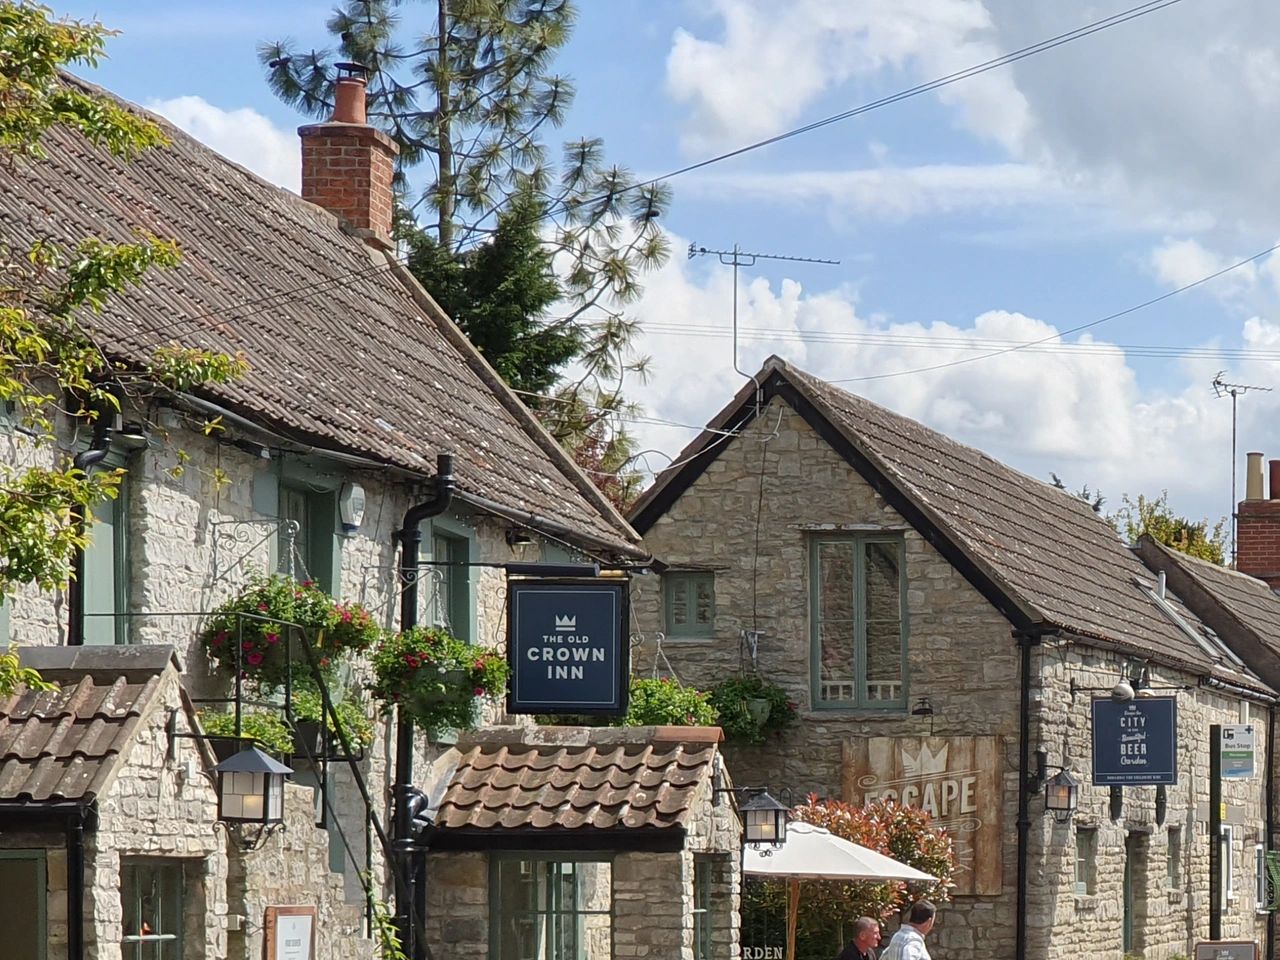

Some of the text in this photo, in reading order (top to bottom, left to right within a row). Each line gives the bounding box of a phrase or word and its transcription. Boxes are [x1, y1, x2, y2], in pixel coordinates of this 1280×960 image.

[542, 635, 589, 643] THE OLD
[527, 647, 605, 662] CROWN
[547, 665, 584, 680] INN
[1120, 716, 1146, 727] CITY
[1120, 743, 1147, 755] BEER
[1236, 742, 1251, 750] Stop
